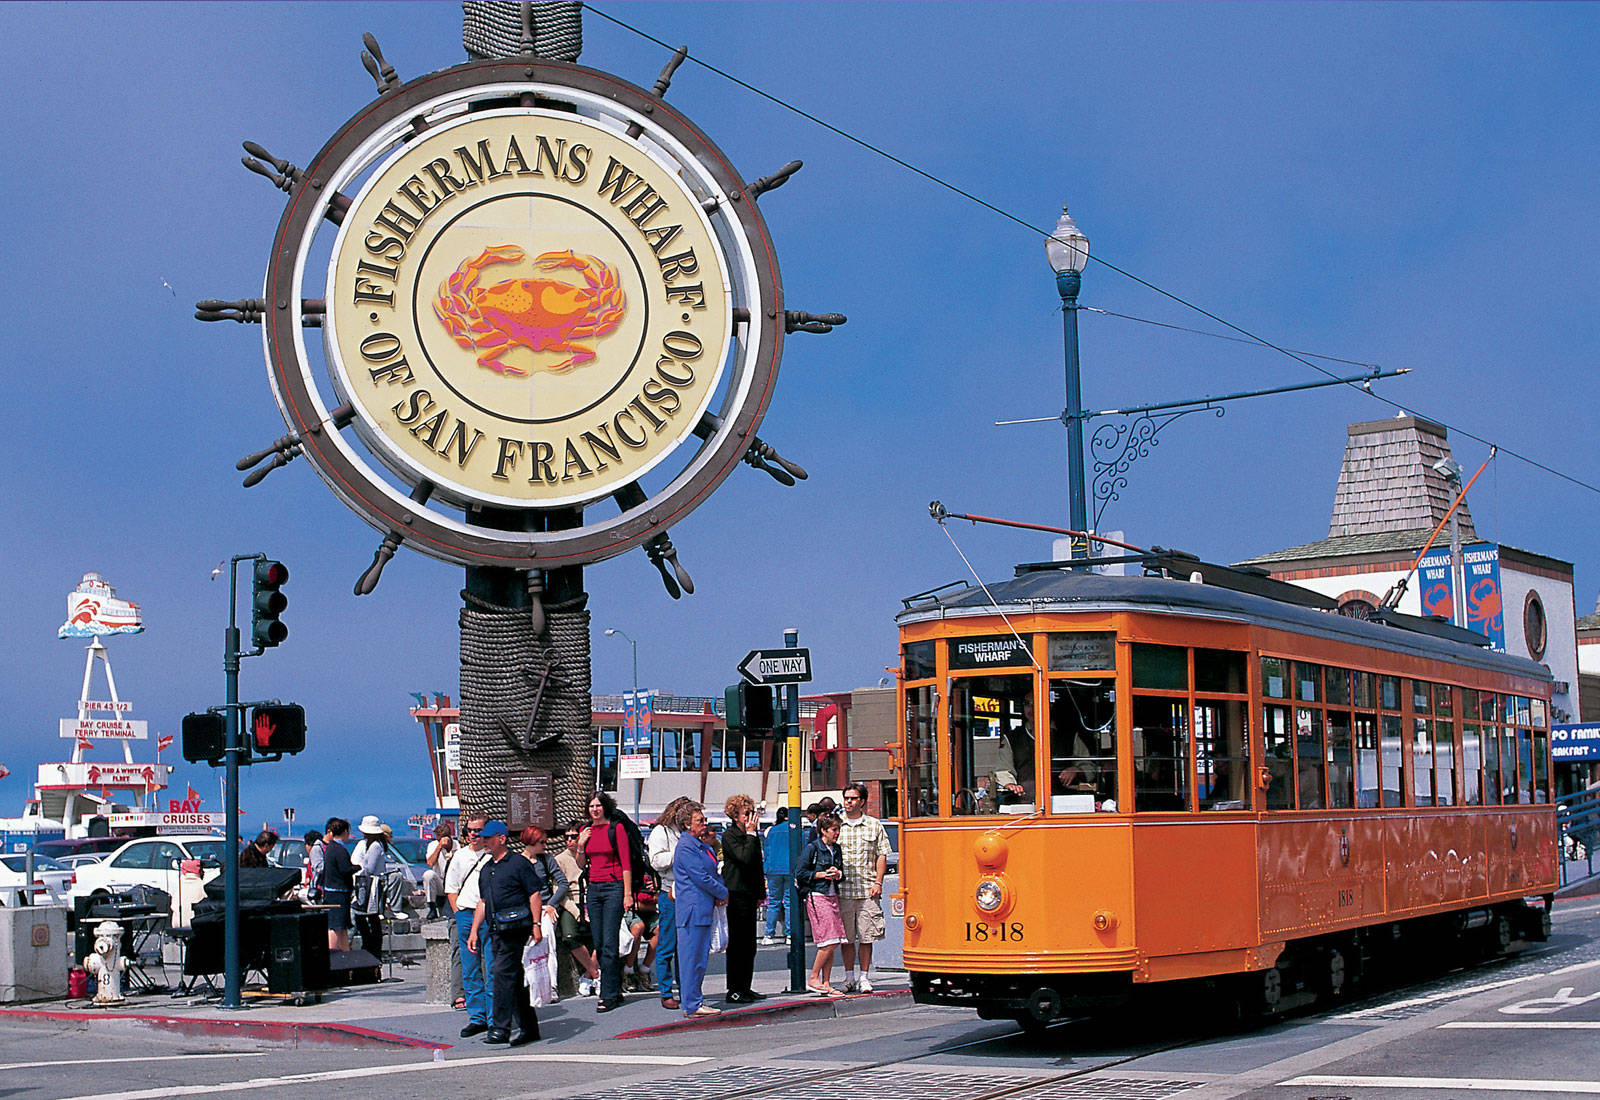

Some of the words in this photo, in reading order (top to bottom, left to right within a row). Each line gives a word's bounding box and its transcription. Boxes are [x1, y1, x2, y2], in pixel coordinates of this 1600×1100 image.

[353, 134, 594, 308] FISHERMANS
[596, 155, 707, 309] WHARF
[358, 331, 418, 388] OF
[391, 388, 484, 470] SAN
[491, 330, 704, 483] FRANCISCO
[1464, 550, 1499, 564] FISHERMAN'S
[1426, 568, 1445, 580] WHARF
[1472, 563, 1492, 575] WHARF
[958, 640, 1027, 654] FISHERMAN'S
[974, 651, 1012, 663] WHARF
[759, 660, 780, 674] ONE
[781, 659, 803, 673] WAY
[85, 702, 102, 710] PIER
[116, 703, 128, 711] 1/2
[80, 721, 94, 729] BAY
[96, 721, 123, 730] CRUISE
[74, 729, 98, 737] FERRY
[101, 730, 136, 738] TERMINAL
[1571, 728, 1600, 740] FAMIL
[169, 800, 202, 813] BAY
[163, 814, 211, 824] CRUISES
[1338, 889, 1353, 907] 1818
